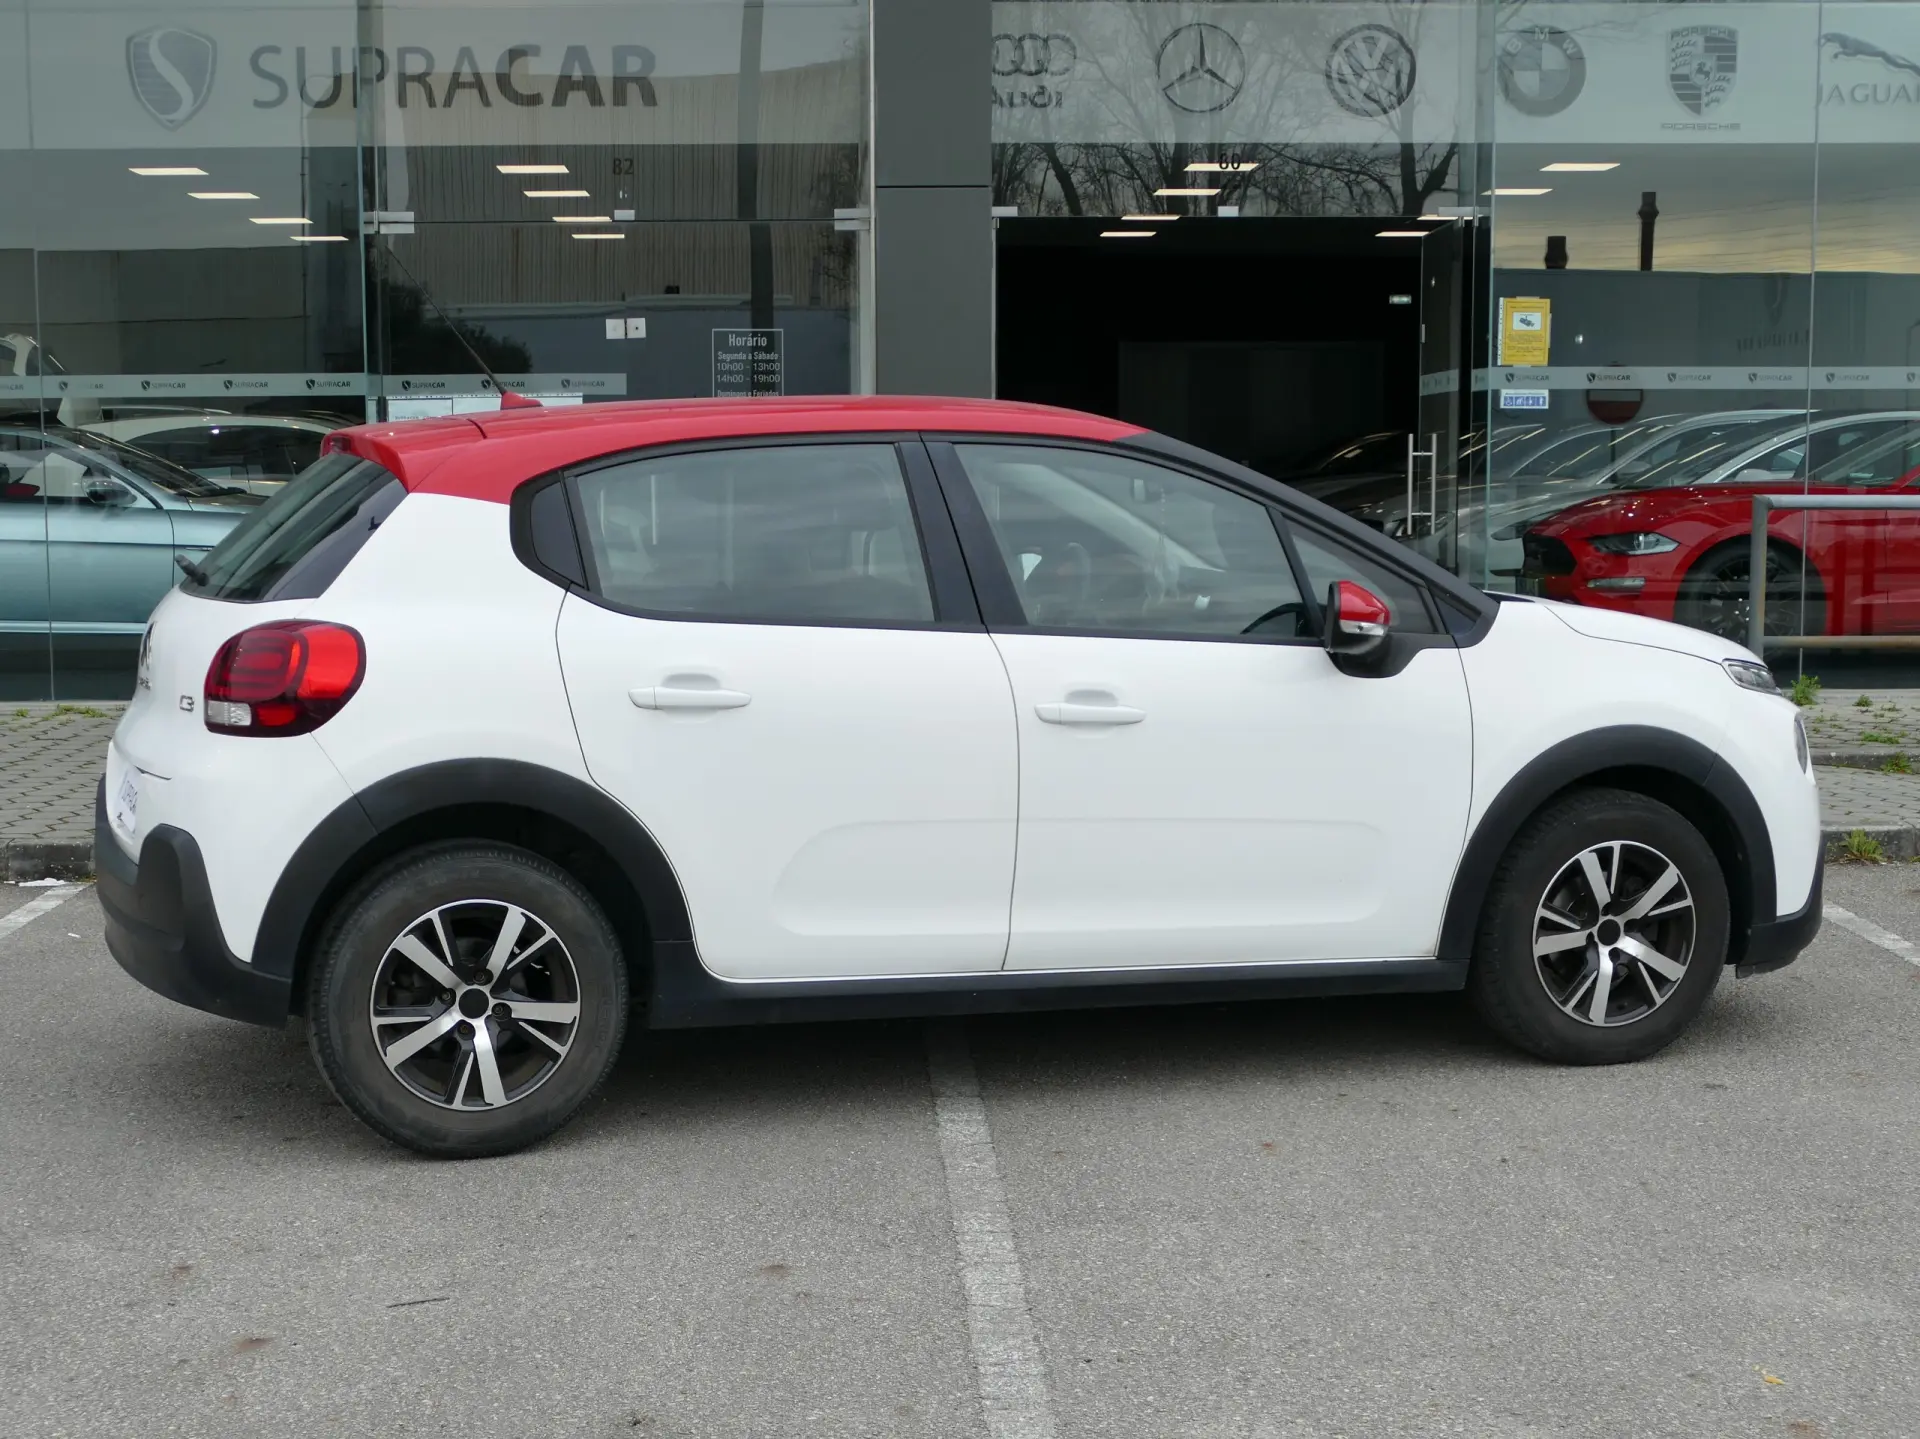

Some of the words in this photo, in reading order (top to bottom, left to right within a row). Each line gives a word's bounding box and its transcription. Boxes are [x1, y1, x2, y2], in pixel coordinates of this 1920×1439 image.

[248, 43, 658, 110] SUPRACAR
[1818, 82, 1920, 106] JAGUA
[613, 158, 634, 175] 82
[728, 333, 768, 347] Horário
[717, 351, 747, 361] Segunda
[753, 351, 779, 360] Sábado
[717, 362, 744, 371] 10h00
[753, 362, 781, 371] 13h00
[717, 374, 744, 383] 14h00
[753, 374, 781, 383] 19h00
